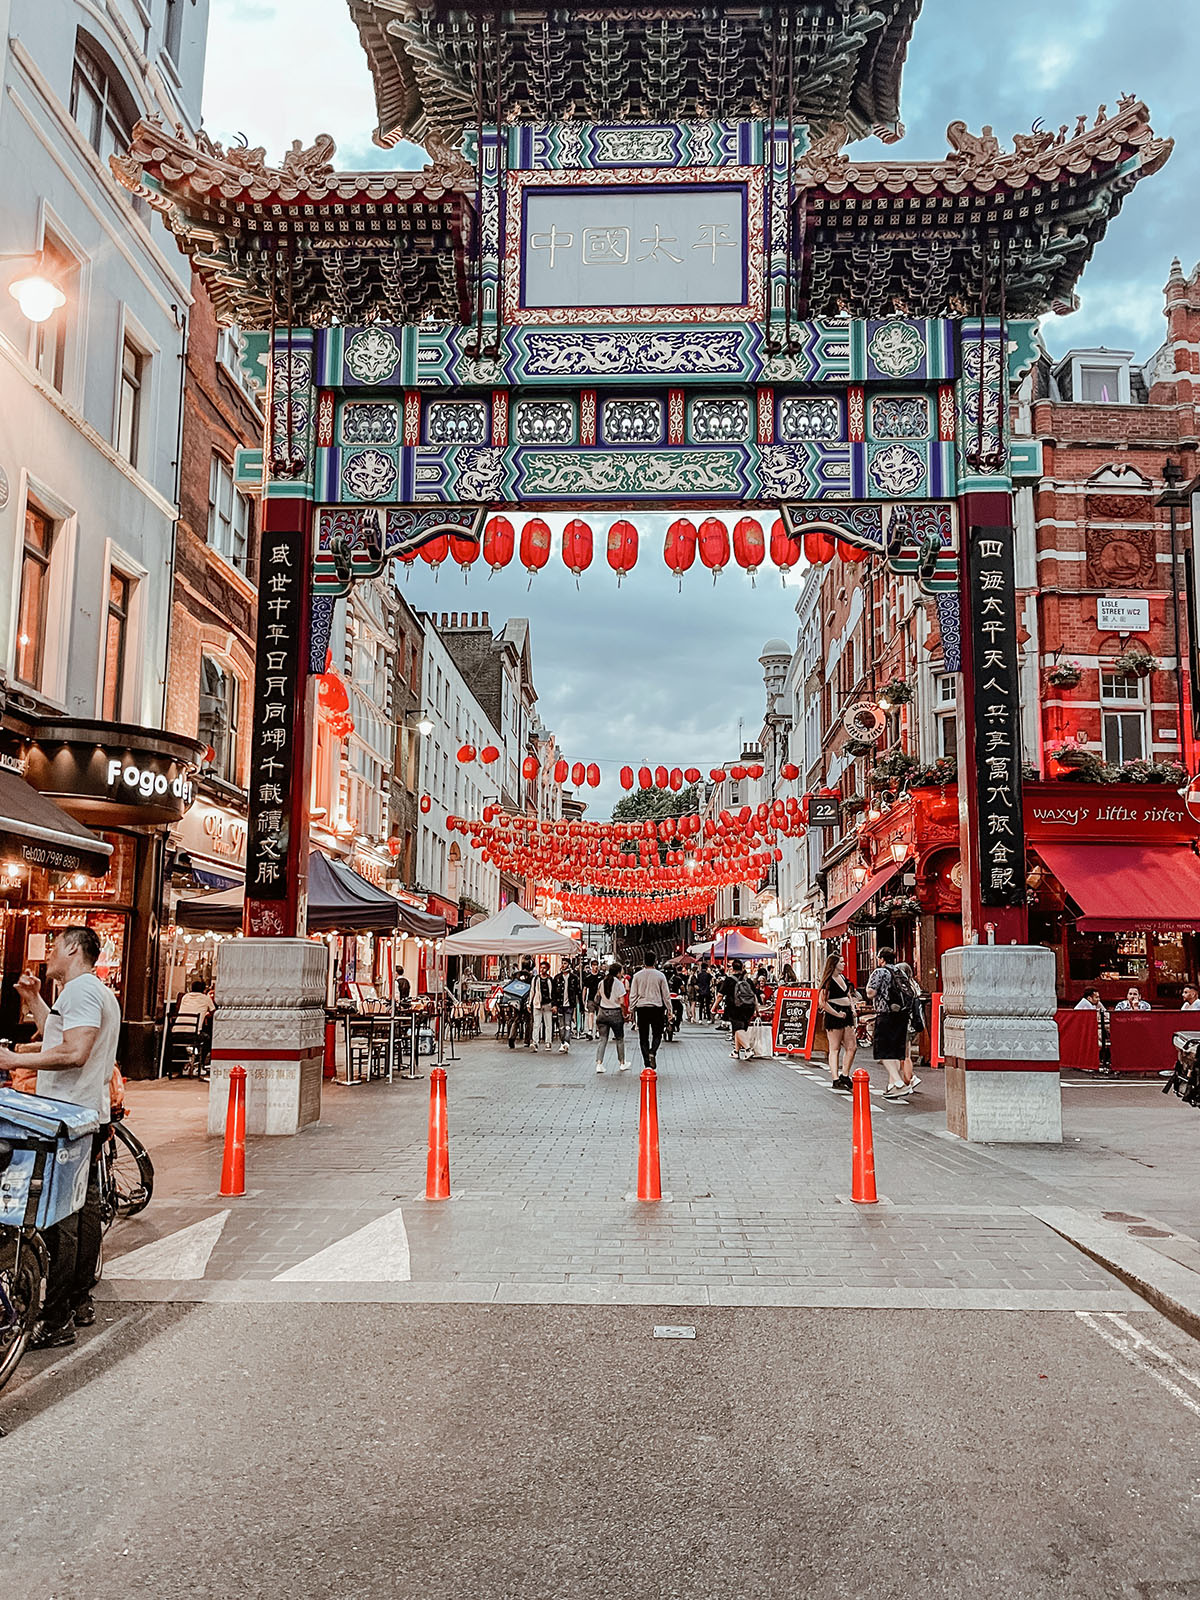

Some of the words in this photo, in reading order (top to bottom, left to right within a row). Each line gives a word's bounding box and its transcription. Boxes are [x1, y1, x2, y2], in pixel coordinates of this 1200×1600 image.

[530, 224, 737, 269] 中國太平
[107, 760, 168, 796] Fogo
[816, 805, 835, 816] 22
[1143, 806, 1184, 822] sister
[0, 875, 21, 888] HOUSE
[783, 990, 811, 998] CAMDEN
